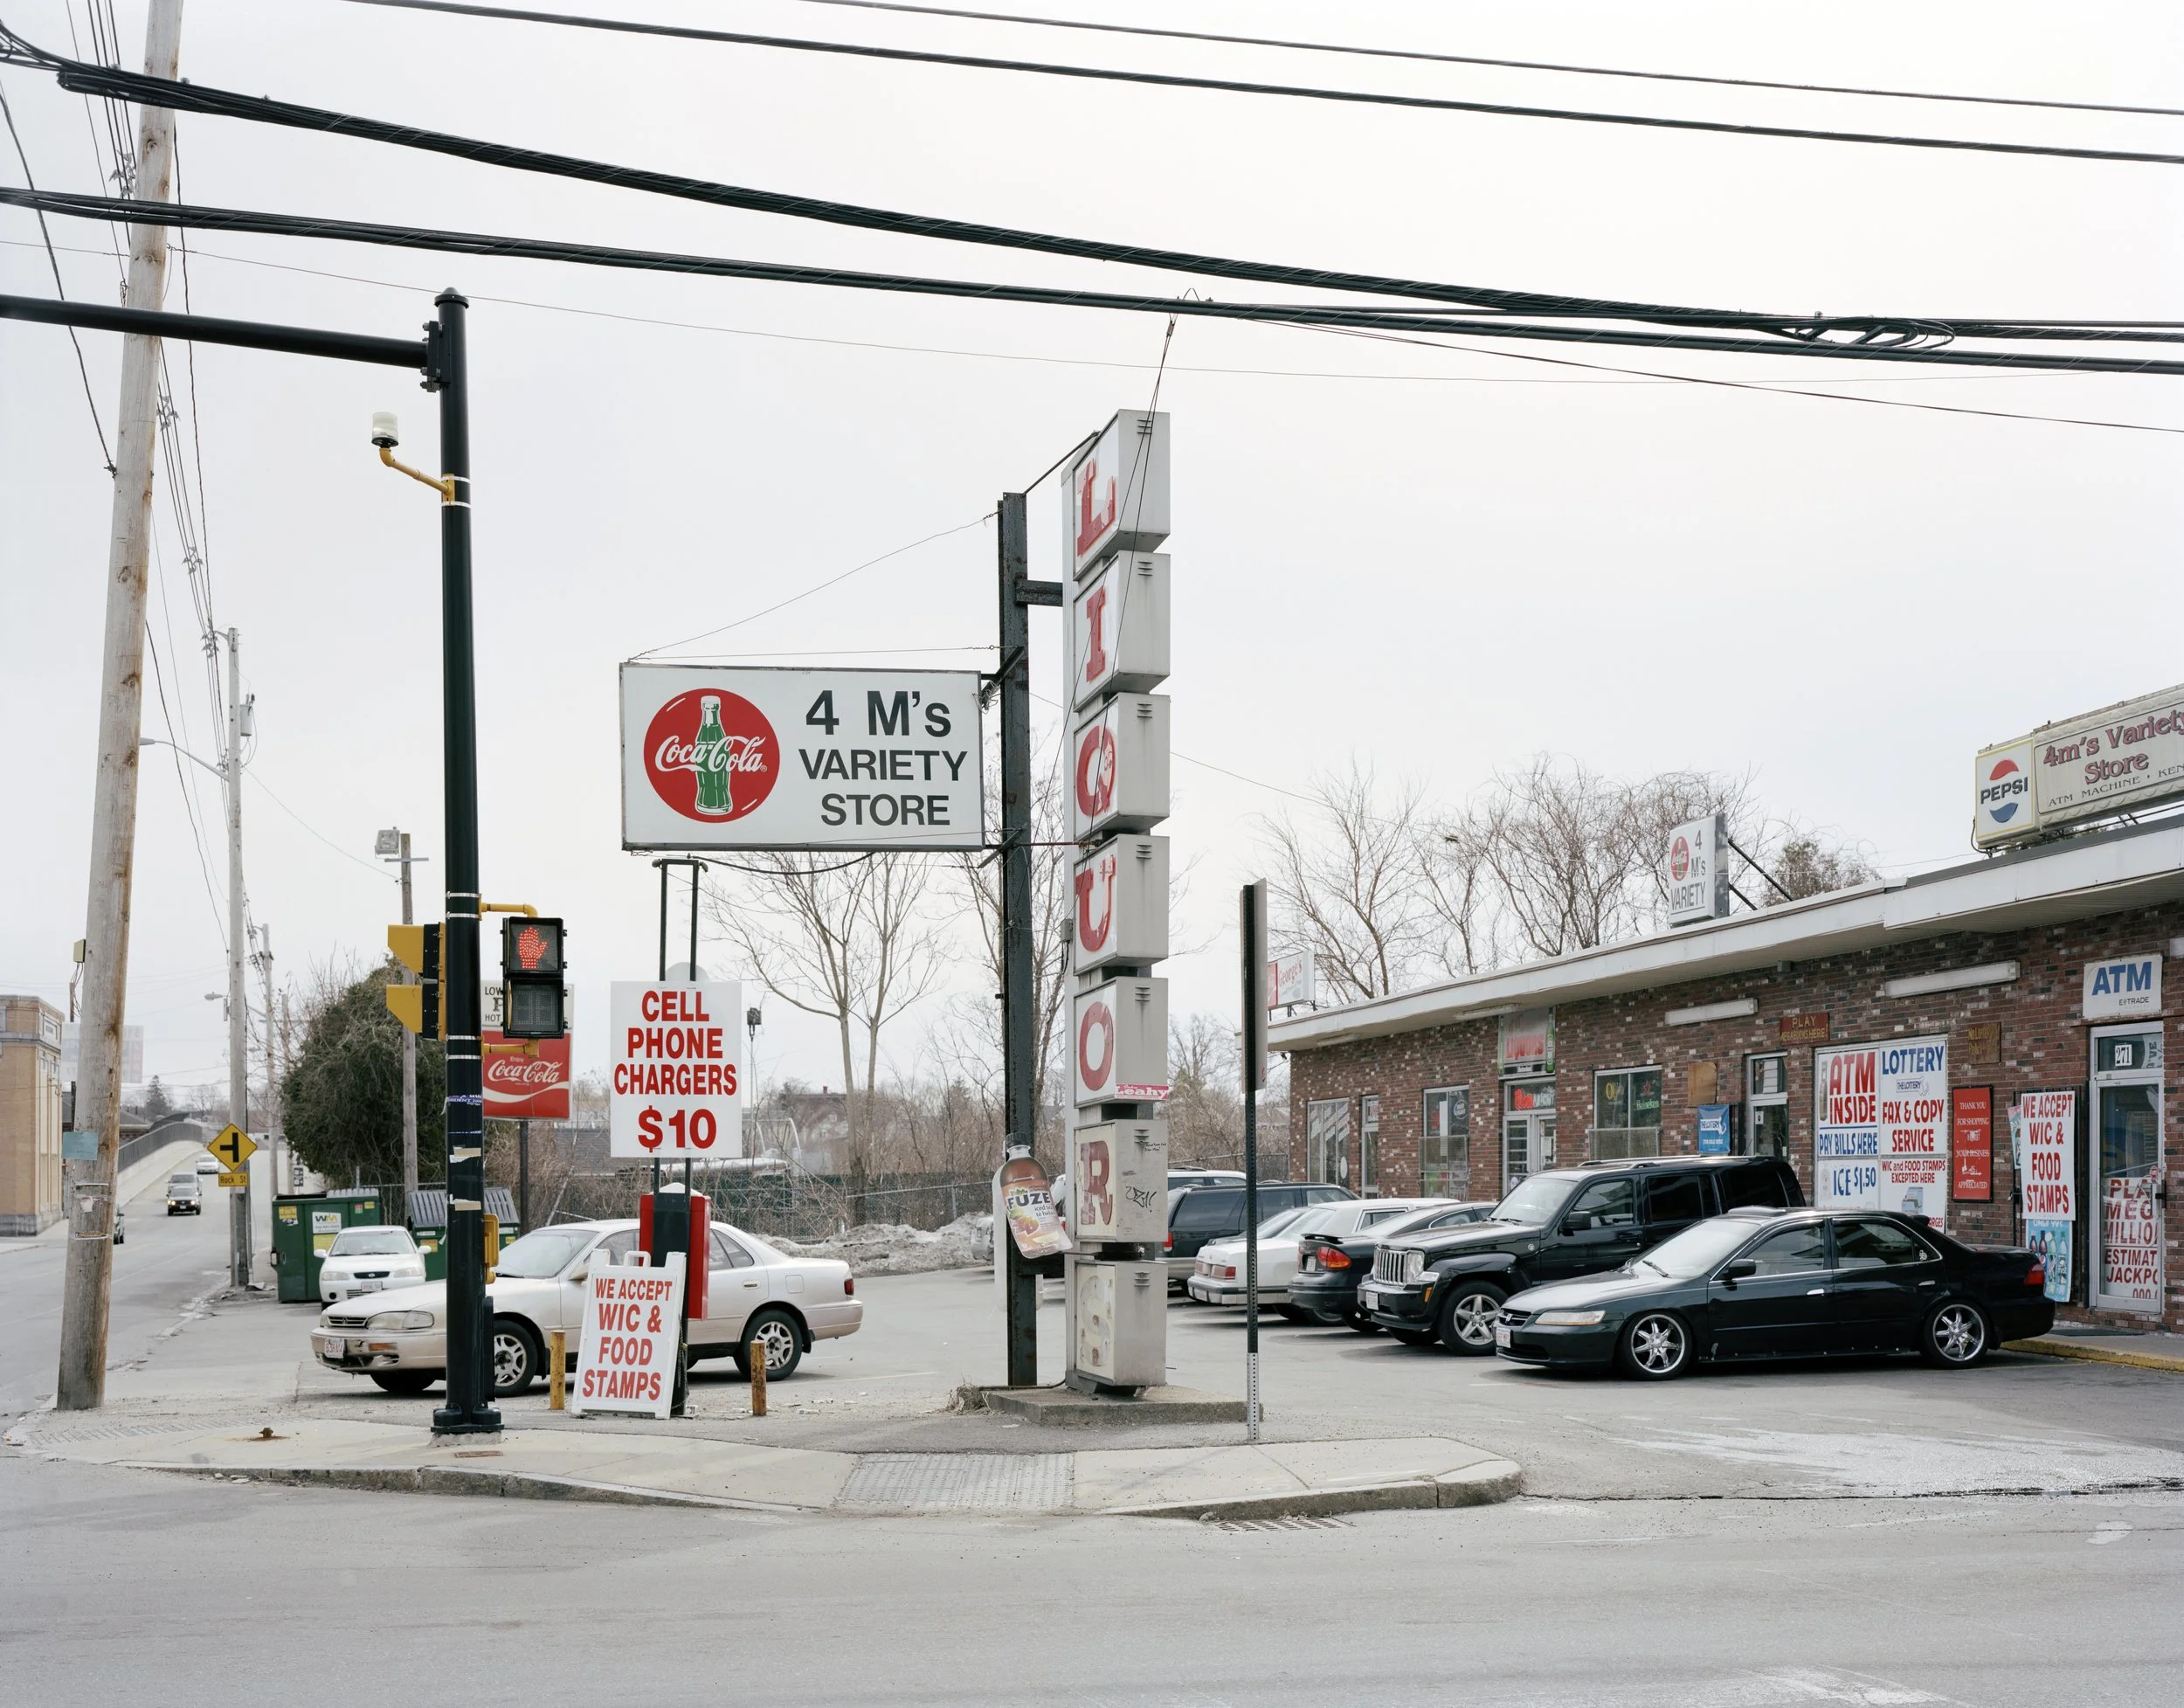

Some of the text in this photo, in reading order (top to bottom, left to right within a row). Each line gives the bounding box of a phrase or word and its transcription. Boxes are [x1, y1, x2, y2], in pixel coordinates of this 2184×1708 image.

[805, 689, 950, 737] 4 M's
[655, 734, 766, 773] Coca-Cola
[798, 749, 967, 781] VARIETY
[2042, 735, 2100, 767] 4m's
[2084, 752, 2149, 785] Store
[1980, 776, 2028, 805] PEPSI
[2049, 793, 2074, 807] ATM
[2081, 775, 2141, 799] MACHINE
[821, 793, 950, 826] STORE
[1695, 830, 1703, 850] 4
[1670, 882, 1706, 910] VARIETY
[2091, 961, 2153, 996] ATM
[641, 990, 709, 1022] CELL
[1792, 1015, 1816, 1028] PLAY
[627, 1027, 723, 1059] PHONE
[2116, 1047, 2130, 1065] 271
[487, 1060, 563, 1083] Coca-Cola
[1829, 1051, 1876, 1096] ATM
[1882, 1046, 1945, 1075] LOTTERY
[614, 1063, 737, 1096] CHARGERS
[1115, 1086, 1168, 1100] Leahy
[1829, 1095, 1876, 1125] INSIDE
[1883, 1099, 1945, 1124] FAX & COPY
[2023, 1094, 2073, 1118] WE ACCEPT
[638, 1105, 716, 1153] $10
[1820, 1132, 1877, 1155] PAY BILLS HERE
[1892, 1129, 1934, 1152] SERVICE
[2029, 1122, 2053, 1145] WIC
[2056, 1122, 2064, 1145] &
[239, 1175, 246, 1184] St
[1882, 1159, 1946, 1172] WIC and FOOD STAMPS
[1891, 1172, 1935, 1183] EXCEPTED HERE
[2031, 1151, 2062, 1180] FOOD
[1833, 1165, 1876, 1196] ICE $1.50
[1007, 1192, 1051, 1210] FUZE
[2026, 1184, 2070, 1214] STAMPS
[2104, 1221, 2158, 1245] MILLIO
[596, 1278, 673, 1302] WE ACCEPT
[598, 1303, 661, 1333] WIC &
[598, 1337, 653, 1366] FOOD
[582, 1369, 661, 1401] STAMPS
